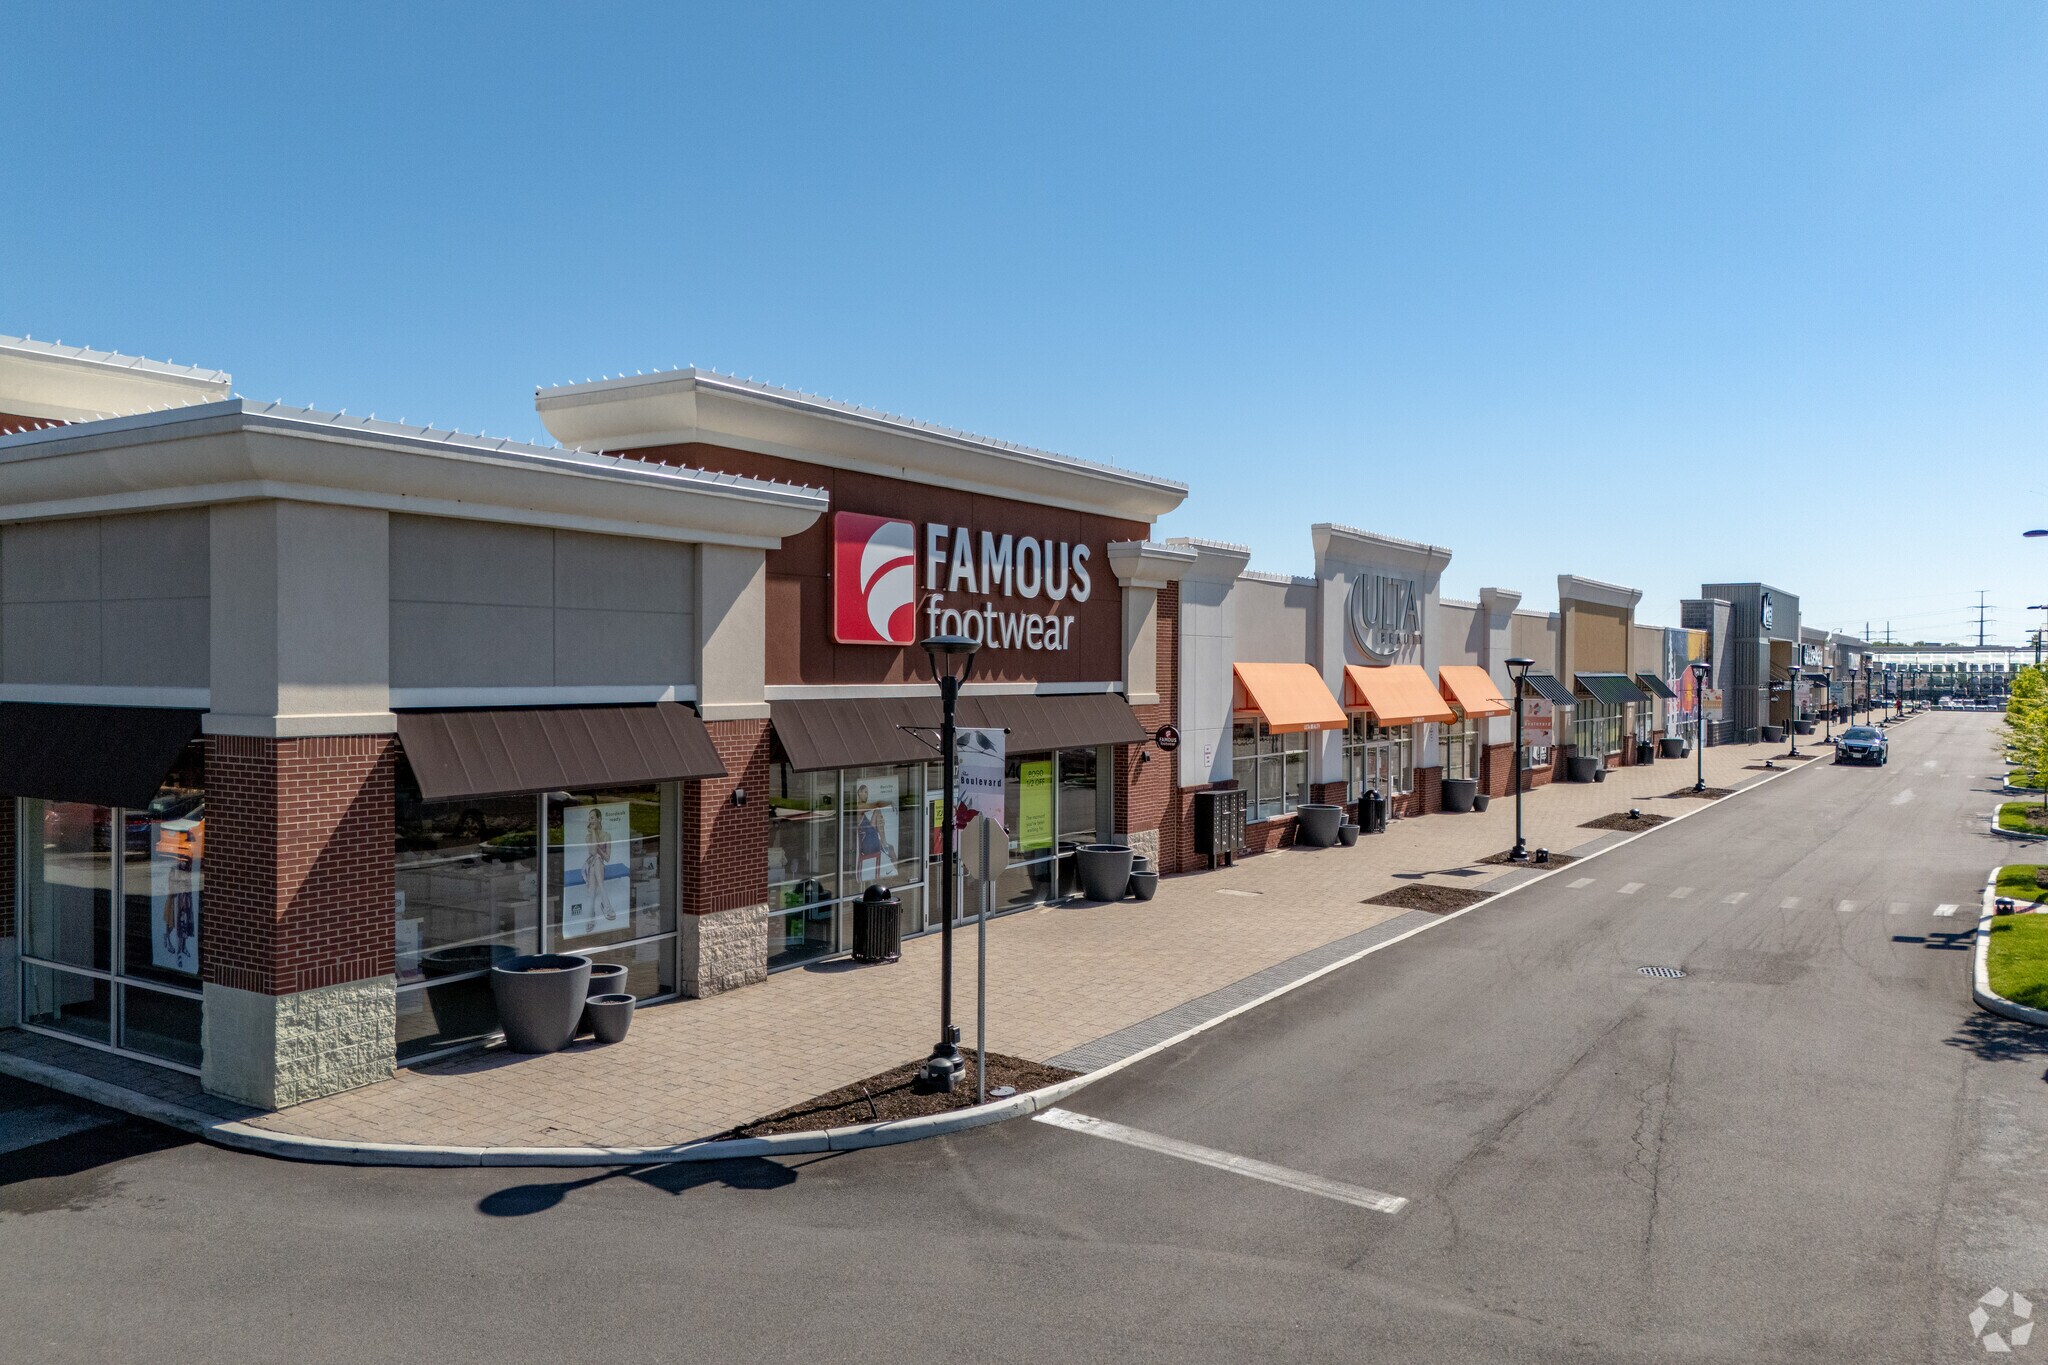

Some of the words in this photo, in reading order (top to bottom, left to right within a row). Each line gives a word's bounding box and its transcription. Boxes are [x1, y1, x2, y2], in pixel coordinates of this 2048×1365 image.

[925, 522, 1091, 603] FAMOUS
[1360, 574, 1421, 632] ULTA
[926, 593, 1075, 650] footwear
[960, 776, 1002, 787] Boulevard
[1027, 769, 1044, 777] BOGO
[1035, 778, 1045, 786] OFF
